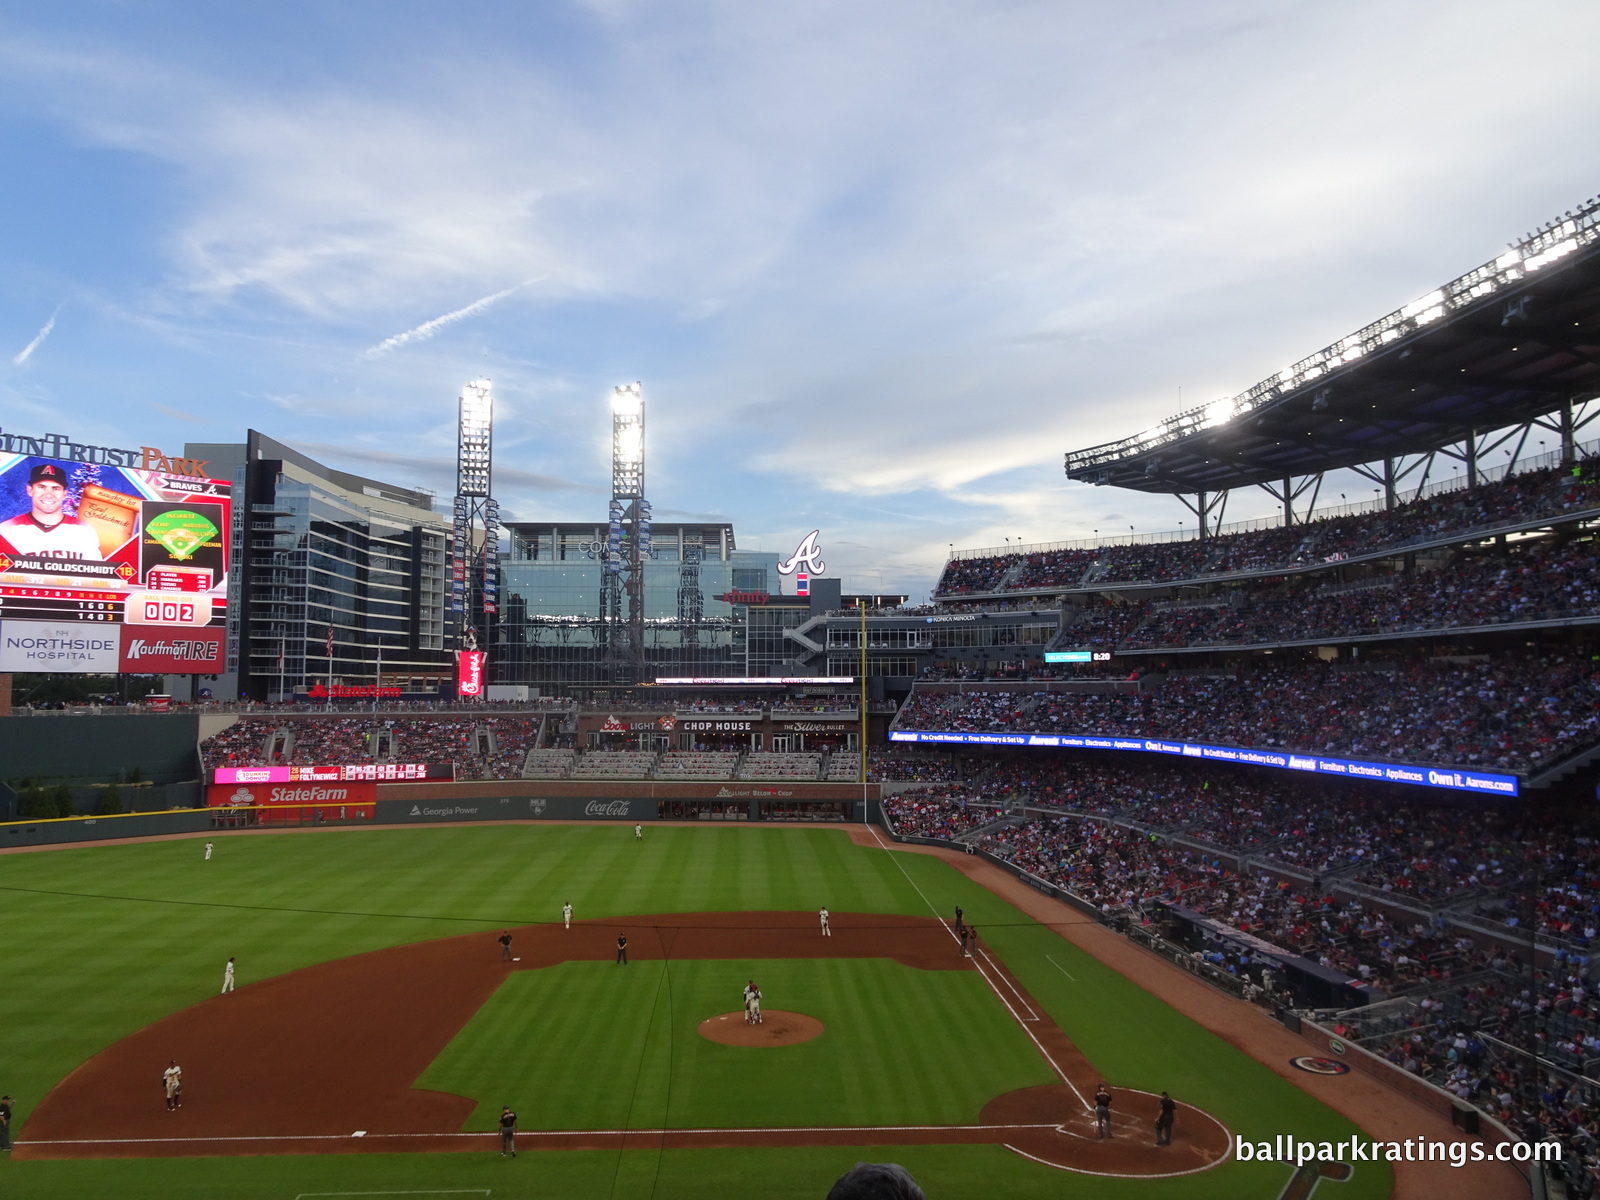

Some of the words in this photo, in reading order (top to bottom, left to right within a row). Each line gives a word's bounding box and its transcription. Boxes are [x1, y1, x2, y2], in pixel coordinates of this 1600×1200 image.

[0, 426, 139, 468] UNTRUST
[140, 446, 209, 478] PARK
[170, 481, 202, 492] BRAVES
[98, 491, 125, 504] naughty
[84, 511, 130, 528] Goldschmidt
[776, 530, 826, 576] A
[14, 560, 43, 570] PAUL
[44, 562, 115, 575] GOLDSCHMIDT
[119, 567, 133, 577] 1B
[5, 575, 24, 583] AVG
[722, 589, 771, 606] xfinity
[146, 604, 158, 618] 0
[164, 605, 176, 619] 0
[182, 606, 193, 620] 2
[7, 637, 114, 650] NORTHSIDE
[127, 639, 188, 659] Kauffman
[172, 640, 219, 660] TIRE
[26, 652, 95, 660] HOSPITAL
[1093, 652, 1111, 660] 8:20
[602, 720, 629, 731] Coors
[630, 722, 656, 730] LIGHT
[684, 722, 712, 730] CHOP
[716, 722, 751, 731] HOUSE
[794, 722, 827, 731] Silver
[981, 736, 1002, 744] Delivery
[1062, 738, 1083, 746] Furniture
[1114, 741, 1142, 749] Appliances
[1210, 749, 1219, 757] Credit
[1220, 751, 1236, 759] Needed
[1239, 752, 1248, 760] Free
[1249, 754, 1266, 764] Delivery
[1278, 757, 1286, 766] Up
[299, 773, 338, 781] FOLTYNEWICZ
[1319, 761, 1346, 773] Furniture
[1349, 764, 1382, 776] Electronics
[1386, 768, 1423, 781] Appliances
[1429, 771, 1453, 786] Own
[1454, 773, 1465, 787] it.
[1466, 777, 1514, 792] Aarons.com
[423, 807, 453, 816] Georgia
[455, 806, 478, 814] Power
[585, 800, 631, 816] Coca-Cola
